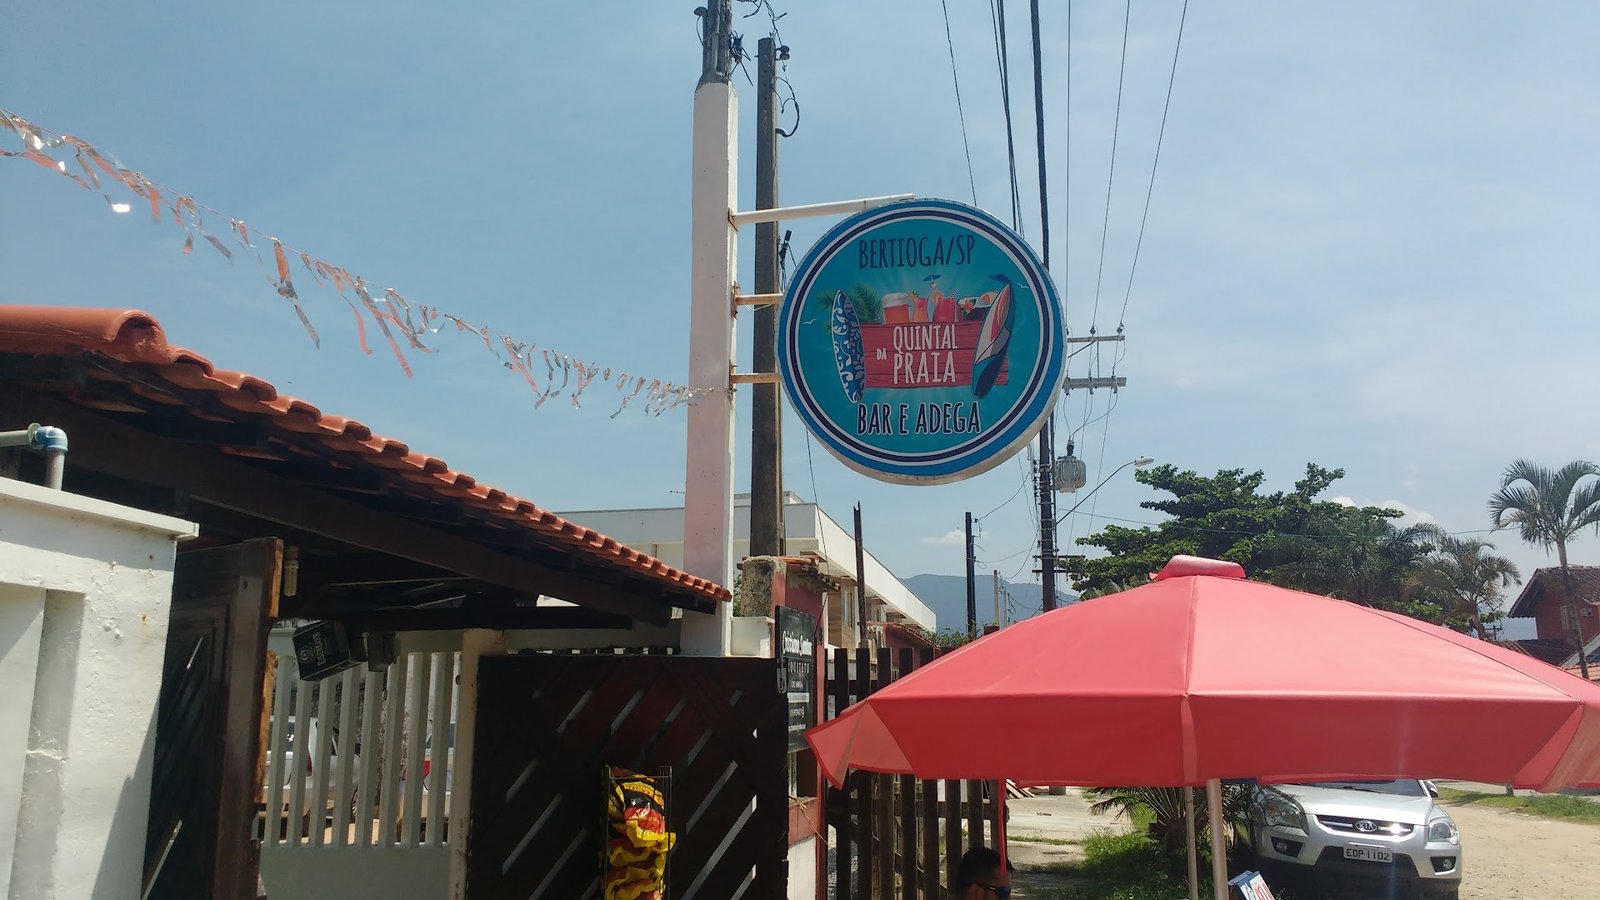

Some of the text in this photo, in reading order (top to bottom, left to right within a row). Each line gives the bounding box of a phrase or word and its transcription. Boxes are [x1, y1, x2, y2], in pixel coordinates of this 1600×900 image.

[859, 234, 976, 269] BERTIOGA/SP
[893, 324, 958, 354] QUINTAL
[876, 348, 956, 384] DA PRAIA
[857, 401, 981, 435] BAR E ADEGA
